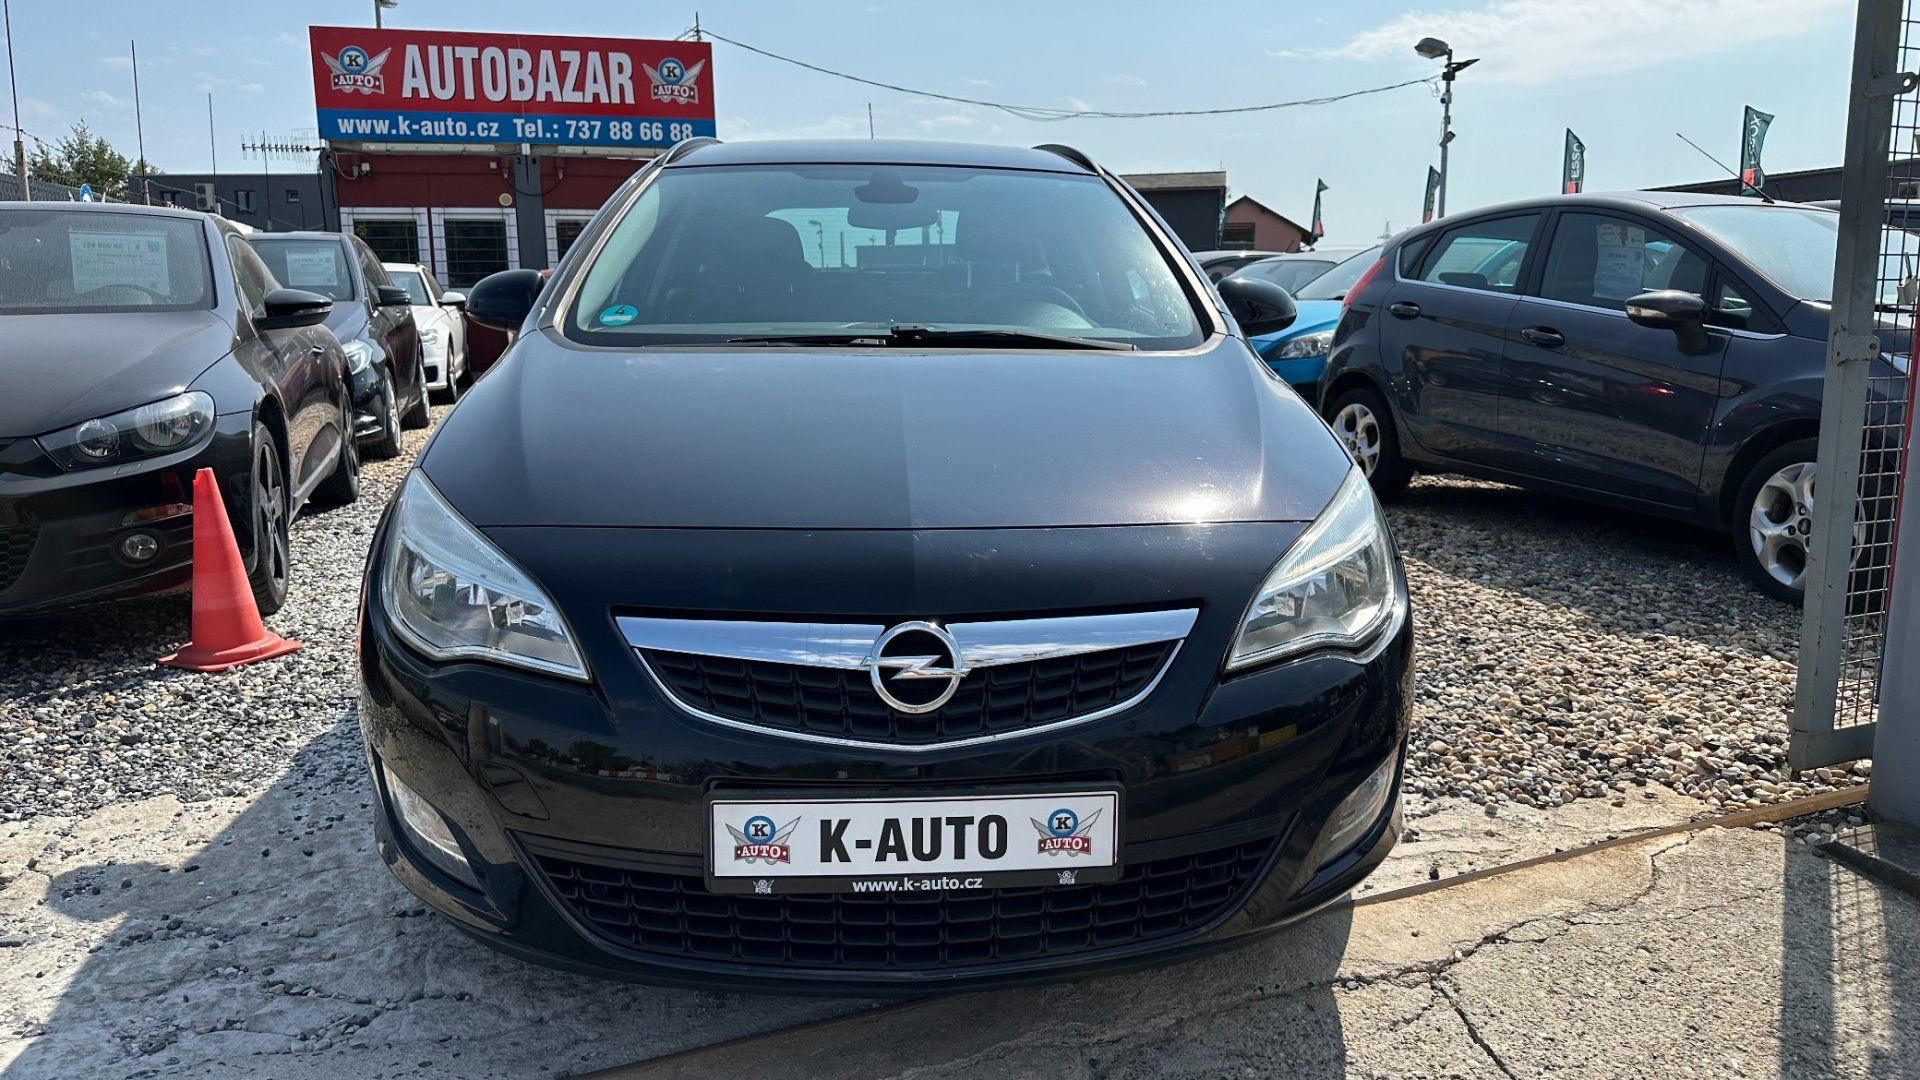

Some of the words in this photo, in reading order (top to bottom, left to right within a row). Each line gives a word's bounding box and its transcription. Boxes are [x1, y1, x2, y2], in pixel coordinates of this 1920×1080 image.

[346, 54, 362, 68] K
[402, 44, 635, 105] AUTOBAZAR
[665, 66, 679, 78] K
[338, 74, 375, 87] AUTO
[657, 84, 690, 98] AUTO
[337, 115, 500, 138] www.k-auto.cz
[512, 118, 558, 139] Tel.:
[565, 119, 601, 140] 737
[609, 121, 633, 141] 88
[639, 122, 663, 142] 66
[670, 123, 693, 141] 88
[1570, 141, 1582, 178] ESSO
[614, 305, 626, 315] 4
[752, 823, 768, 837] K
[1055, 816, 1071, 830] K
[820, 814, 1008, 863] K-AUTO
[1044, 837, 1083, 850] AUTO
[740, 845, 781, 858] AUTO
[852, 876, 983, 892] www.k-auto.cz
